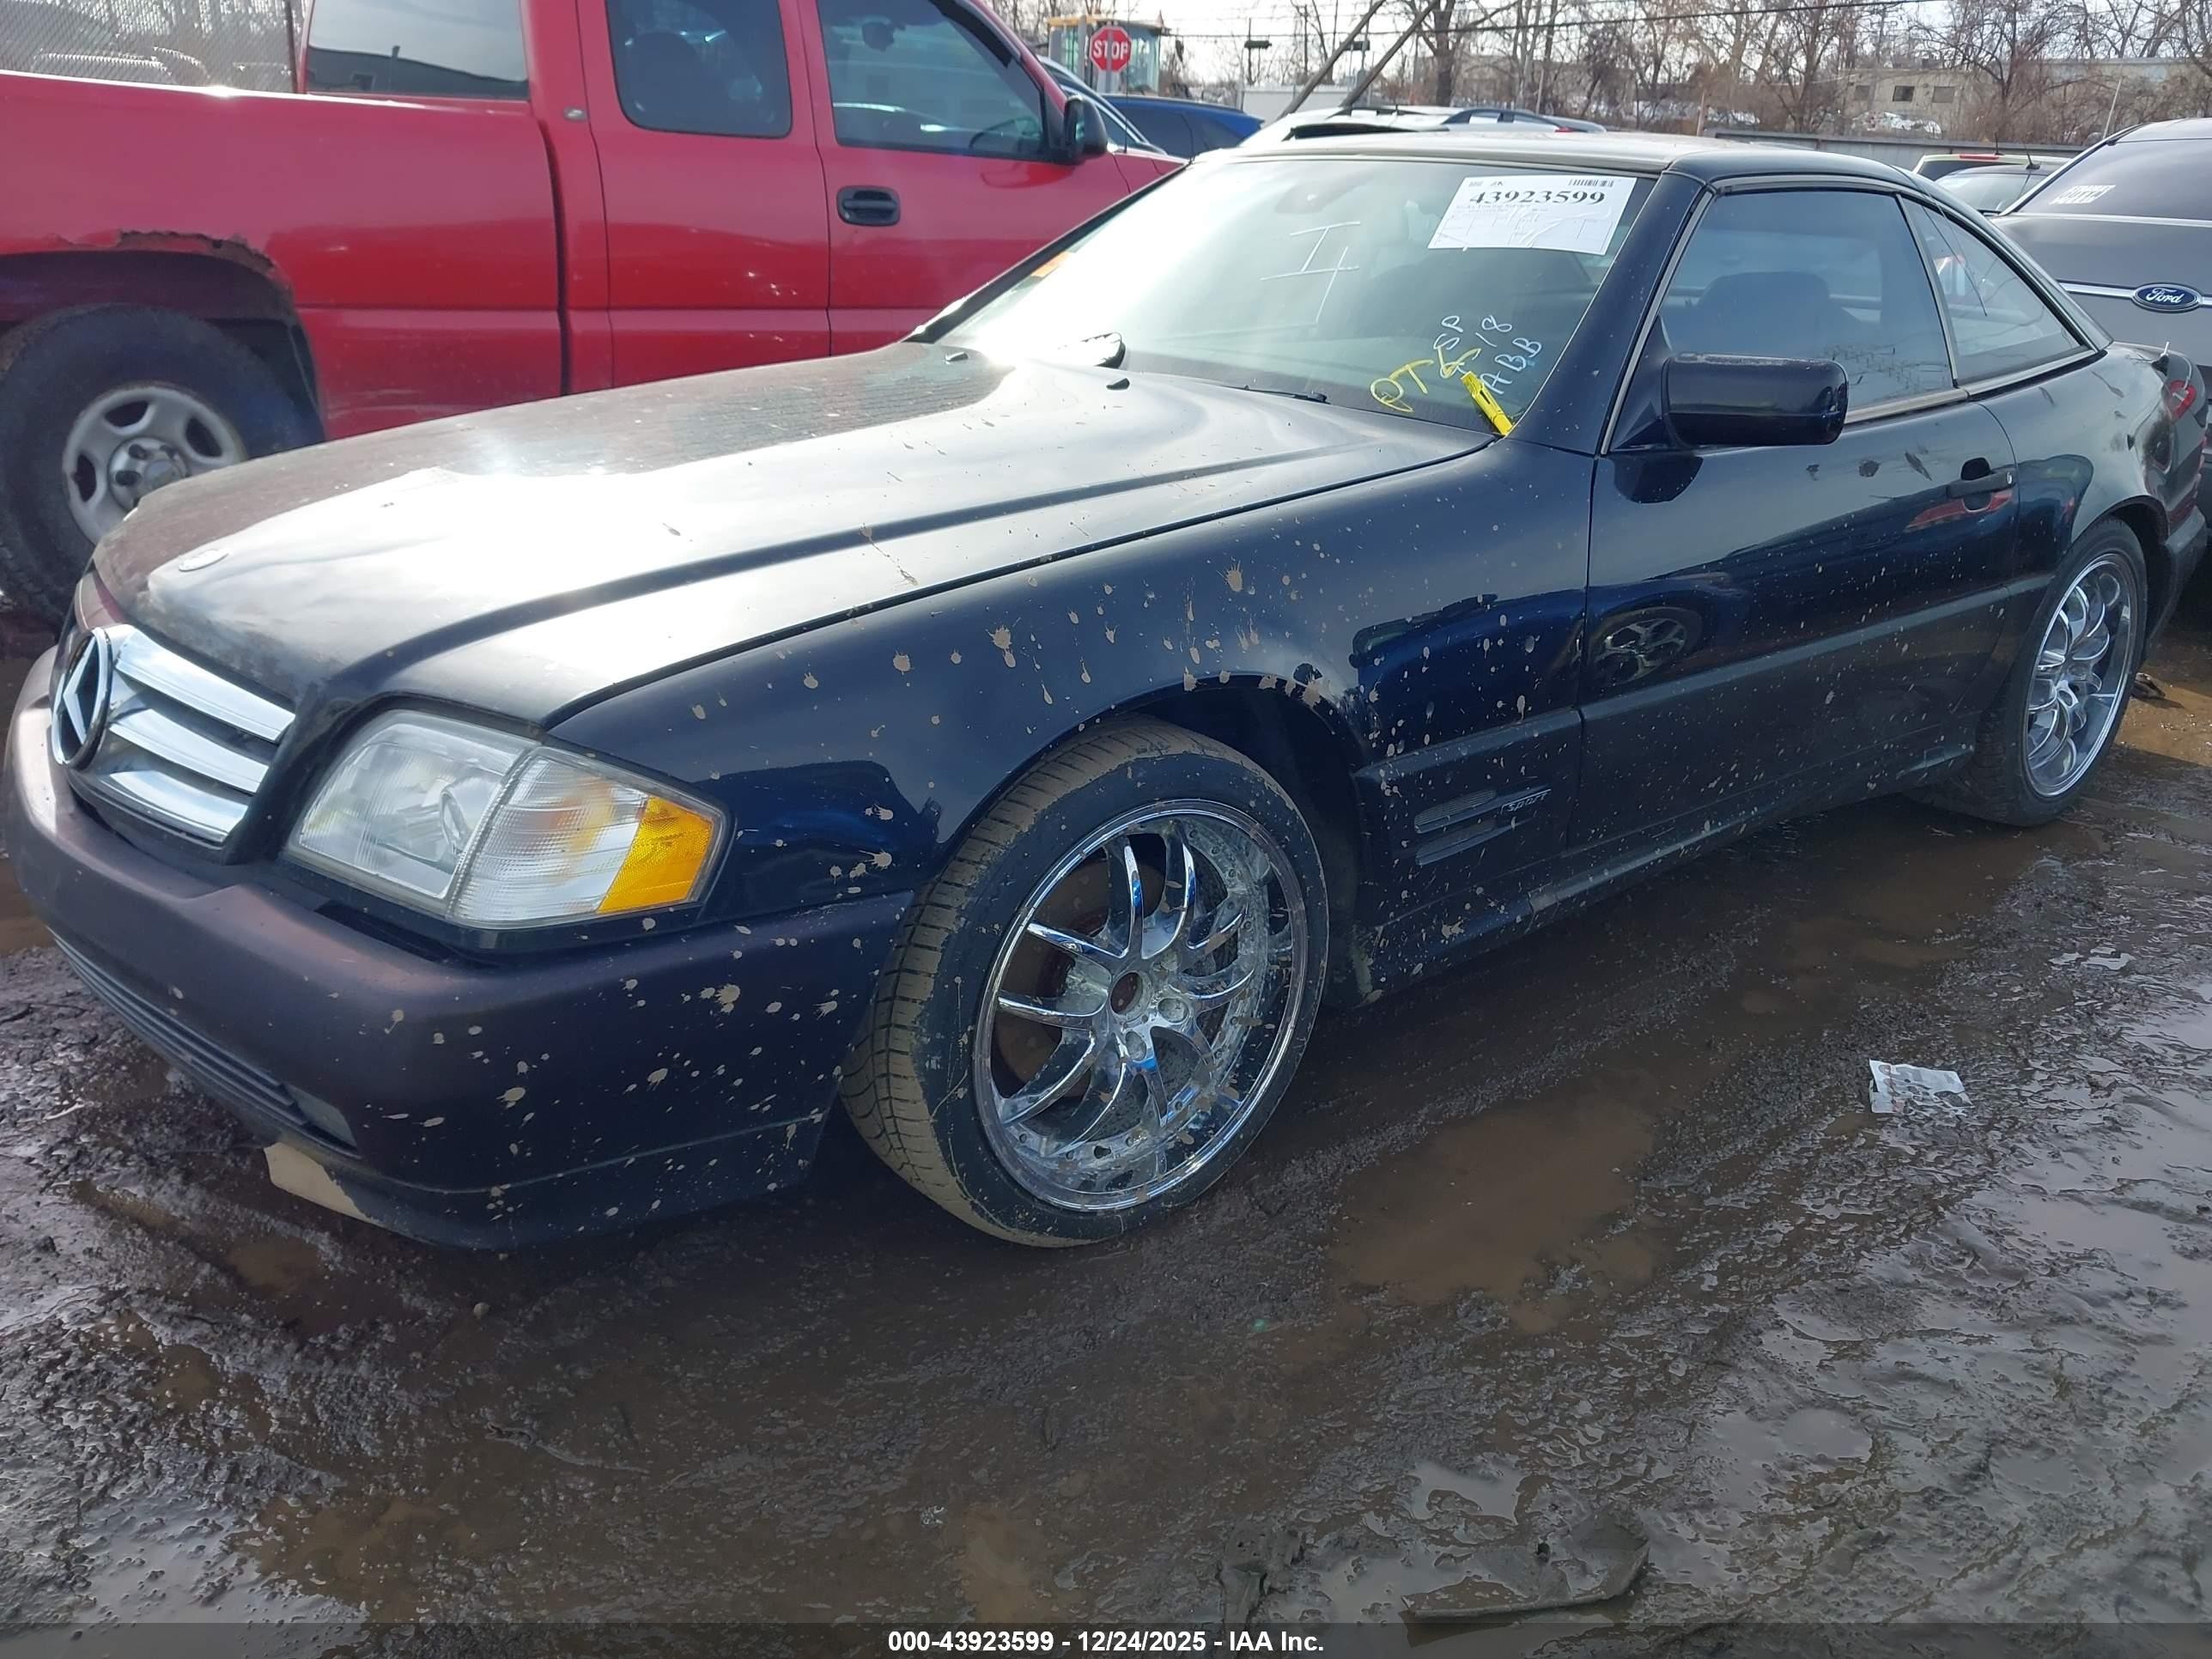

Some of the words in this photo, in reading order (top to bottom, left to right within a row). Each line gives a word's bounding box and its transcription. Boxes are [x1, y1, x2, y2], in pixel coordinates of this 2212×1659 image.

[1093, 40, 1128, 59] STOP
[1469, 190, 1605, 205] 43923599
[2145, 287, 2185, 303] Ford
[1480, 337, 1542, 394] ABB
